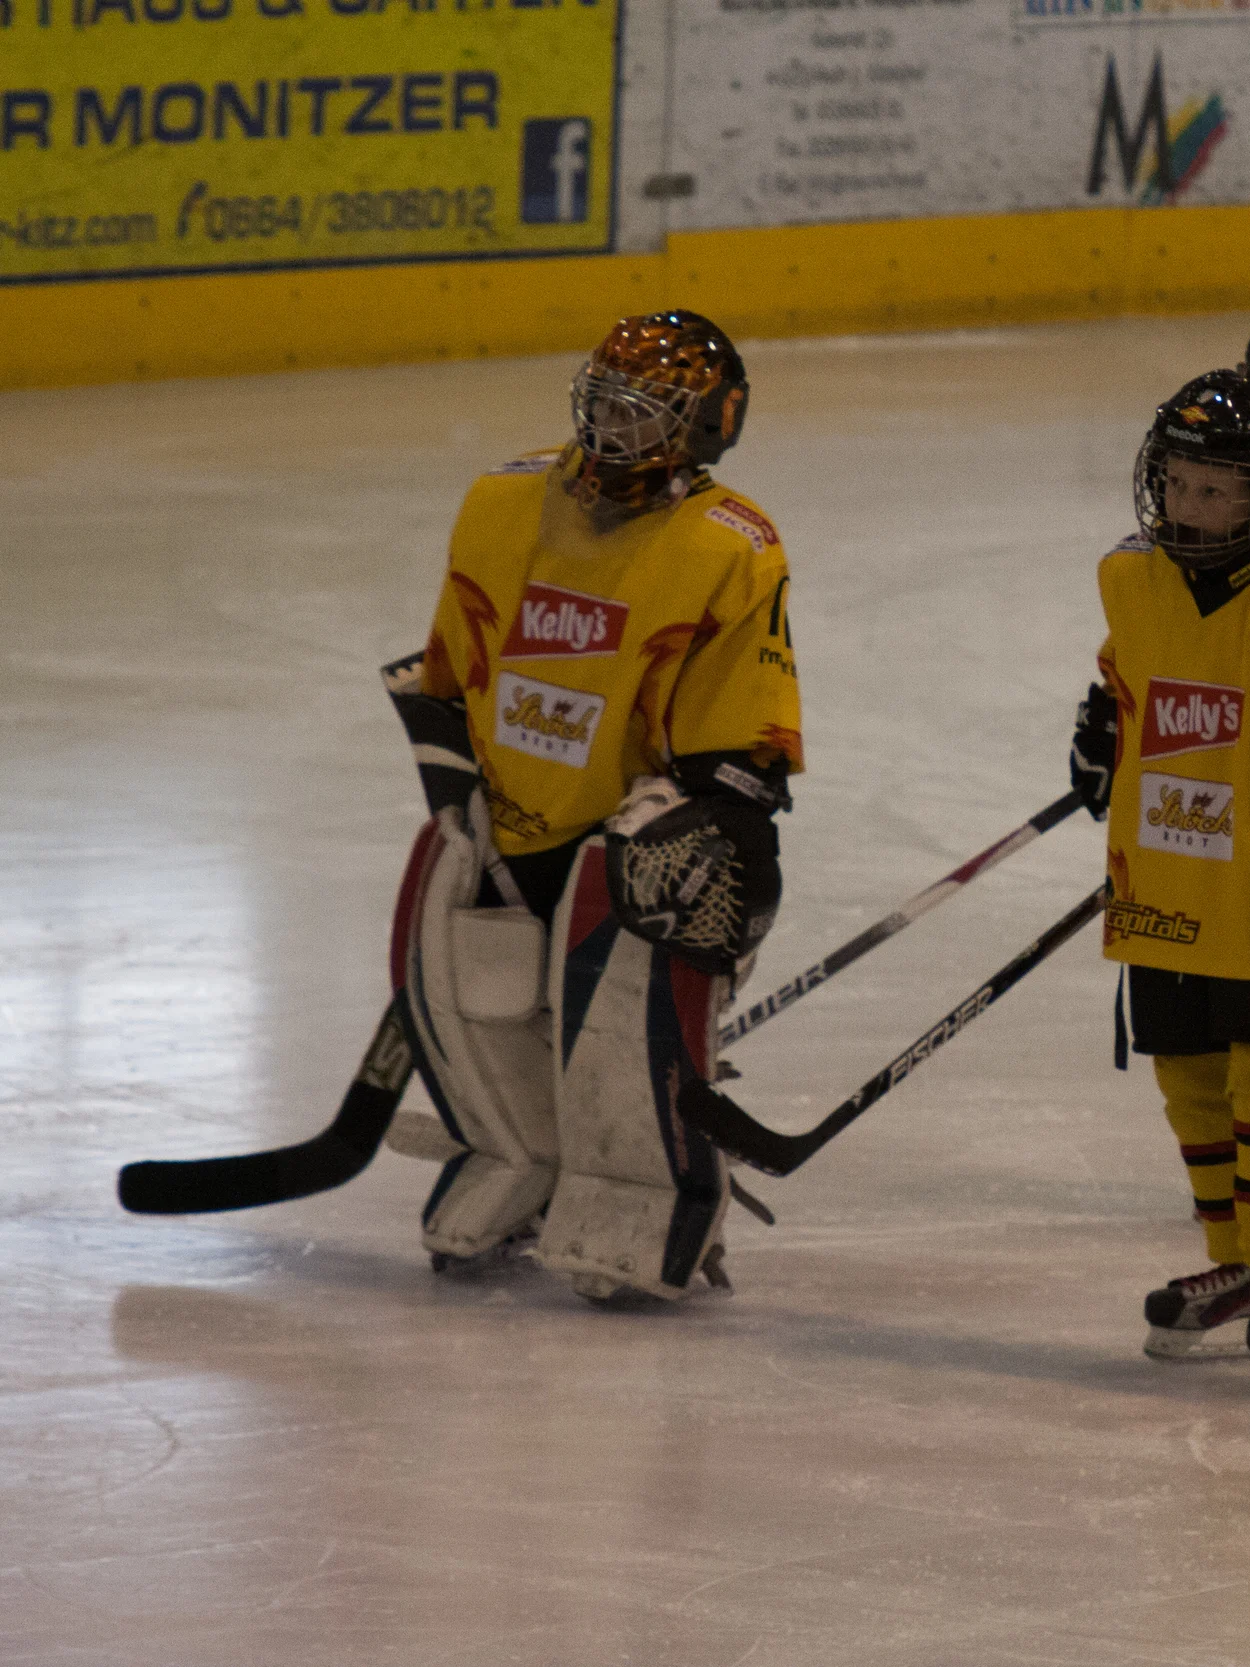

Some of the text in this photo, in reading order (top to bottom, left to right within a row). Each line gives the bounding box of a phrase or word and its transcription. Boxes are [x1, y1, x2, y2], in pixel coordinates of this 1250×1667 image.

[74, 70, 500, 147] MONITZER
[522, 599, 609, 651] Kelly's
[1154, 694, 1240, 741] Kelly's
[888, 984, 996, 1090] FISCHER
